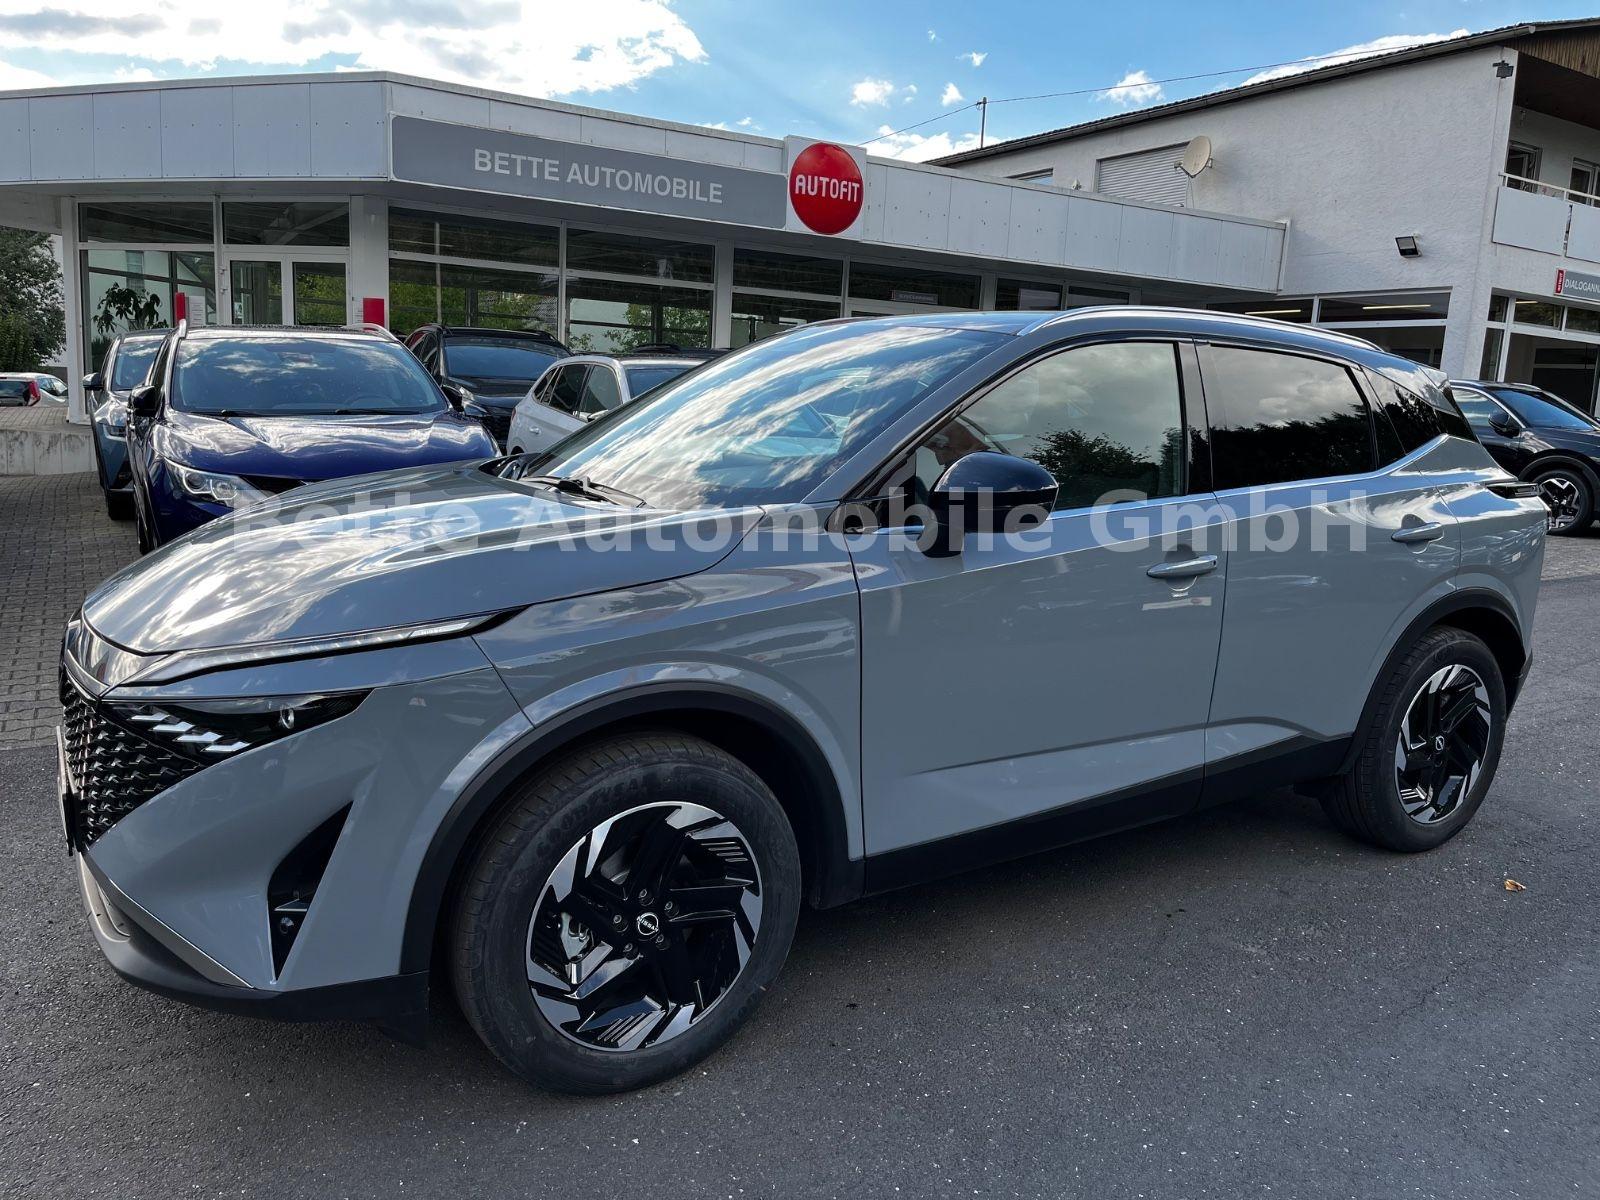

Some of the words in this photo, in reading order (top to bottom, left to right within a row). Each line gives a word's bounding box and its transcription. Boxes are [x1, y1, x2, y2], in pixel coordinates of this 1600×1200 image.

[474, 149, 560, 181] BETTE
[566, 162, 723, 204] AUTOMOBILE
[795, 174, 860, 203] AUTOFIT
